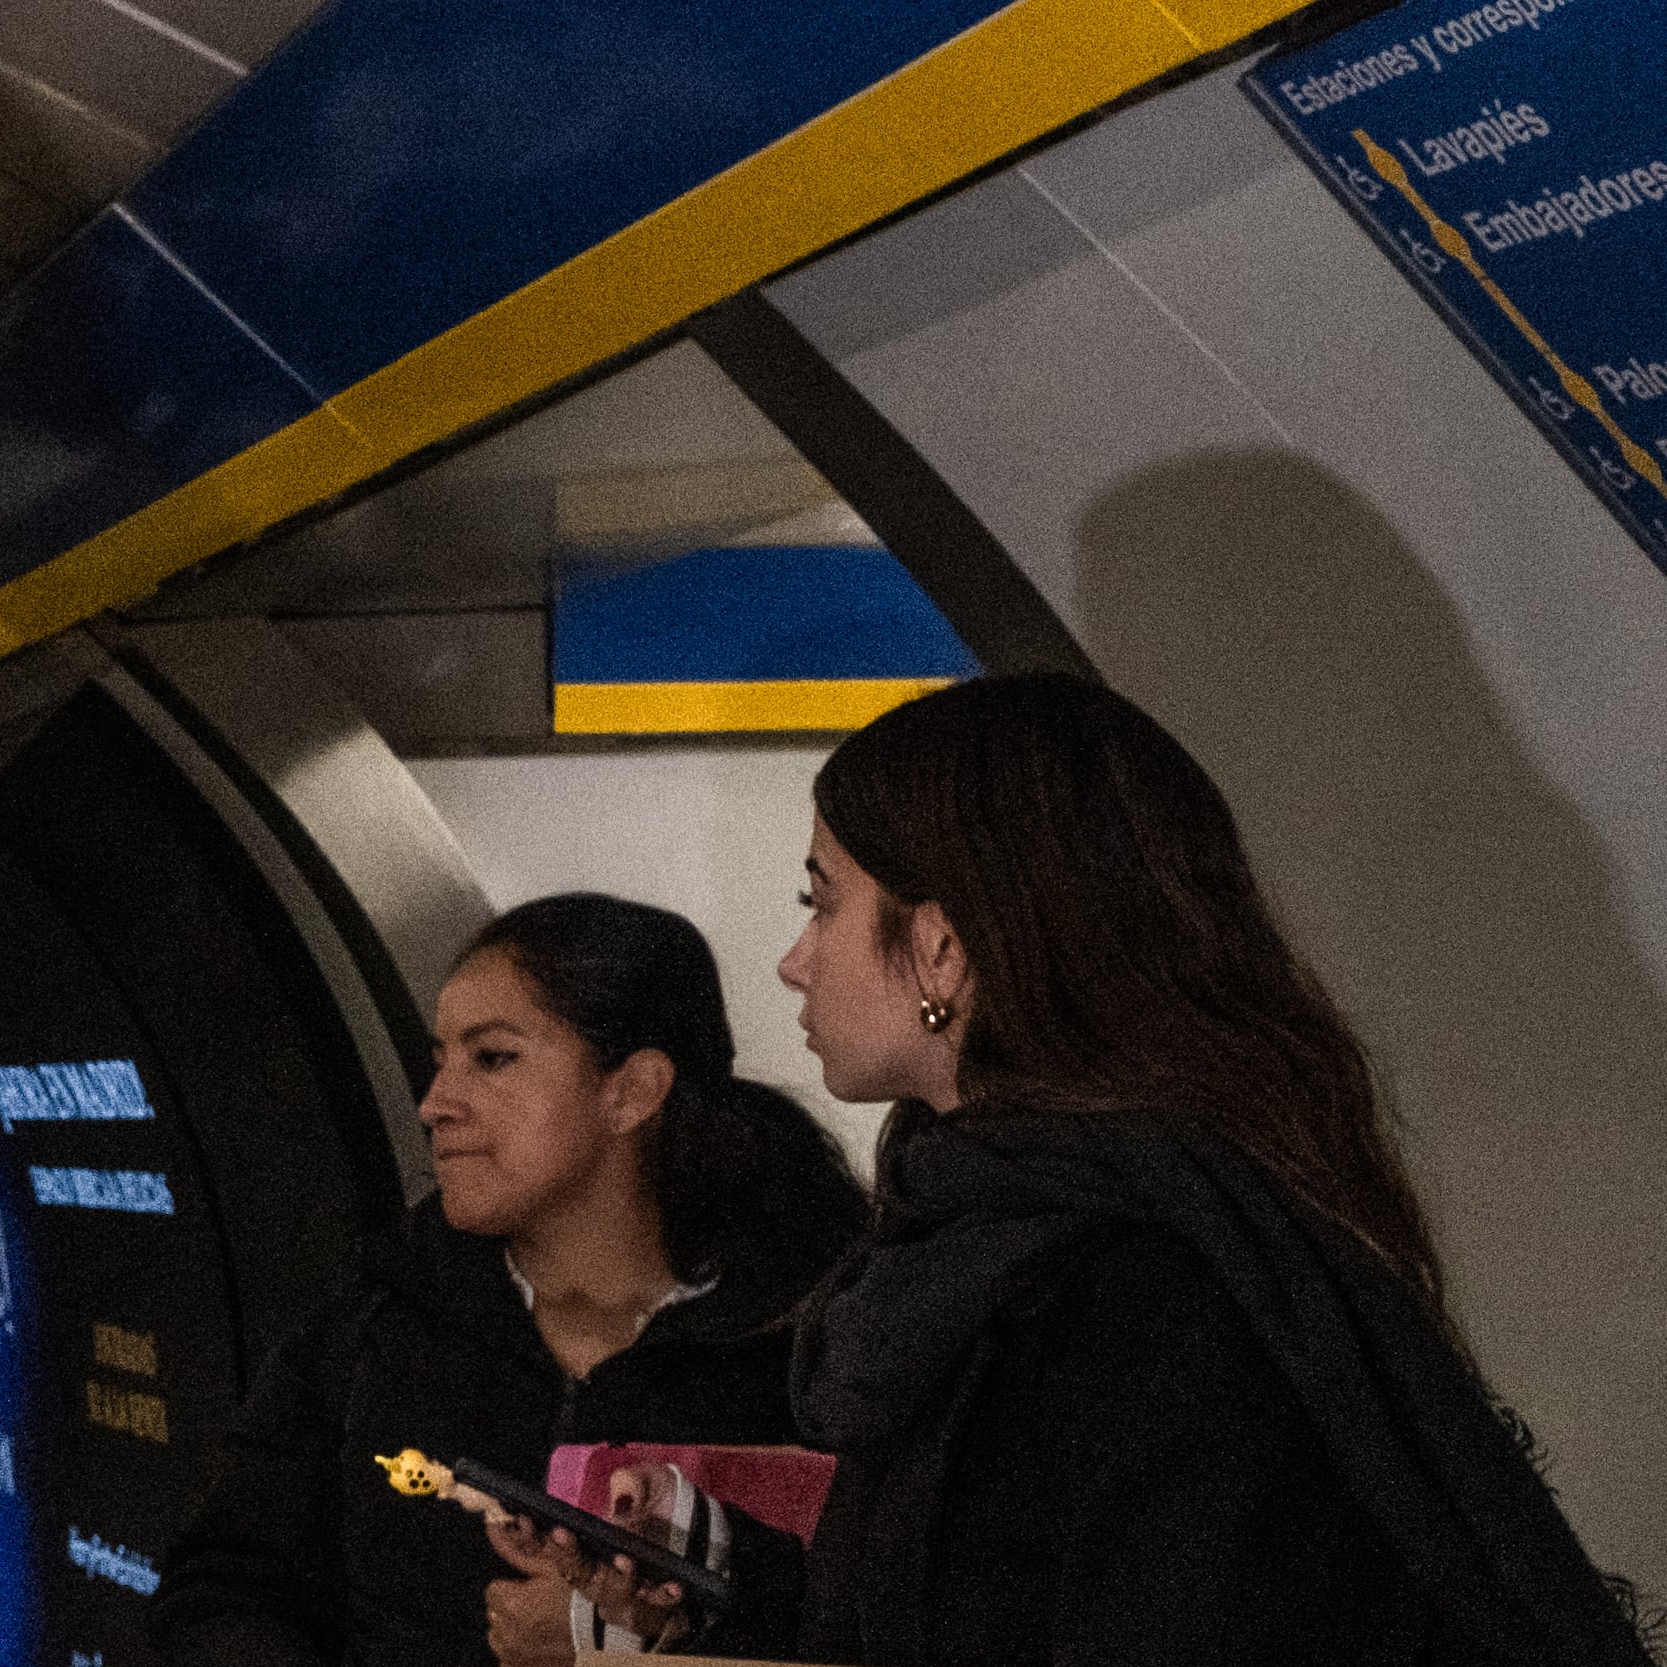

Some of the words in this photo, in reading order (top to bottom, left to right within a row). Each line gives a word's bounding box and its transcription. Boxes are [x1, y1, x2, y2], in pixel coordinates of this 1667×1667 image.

[1280, 43, 1418, 116] Estaciones
[1410, 34, 1442, 73] y
[1398, 99, 1550, 178] Lavapiés
[1461, 161, 1667, 252] Embajadores
